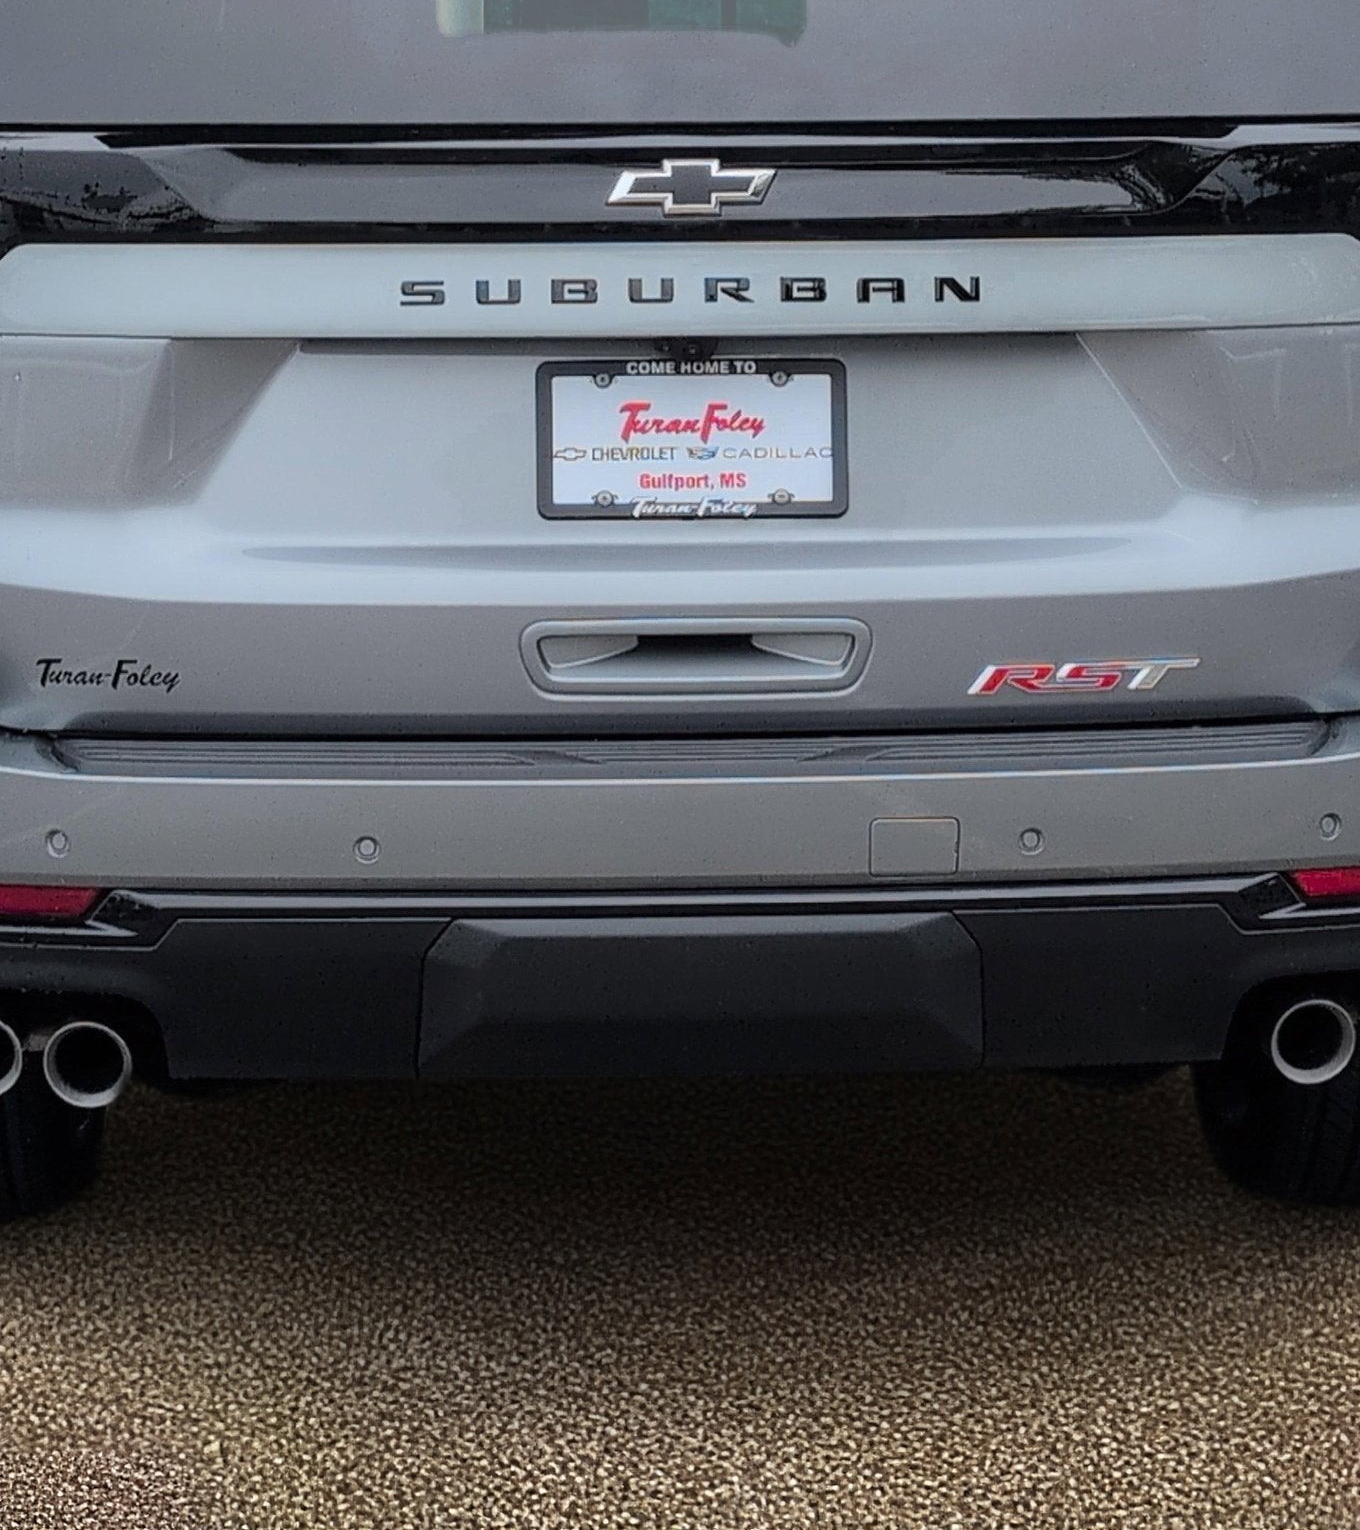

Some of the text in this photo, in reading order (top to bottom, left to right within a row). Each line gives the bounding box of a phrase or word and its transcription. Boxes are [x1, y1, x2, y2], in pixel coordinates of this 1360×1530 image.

[400, 276, 980, 306] SUBURBAN
[626, 360, 757, 374] COME HOME TO
[619, 401, 765, 445] Turan Foley
[592, 446, 833, 461] CHEVROLET CADILLAC
[640, 472, 747, 491] Gulfport, MS
[967, 657, 1201, 695] RST
